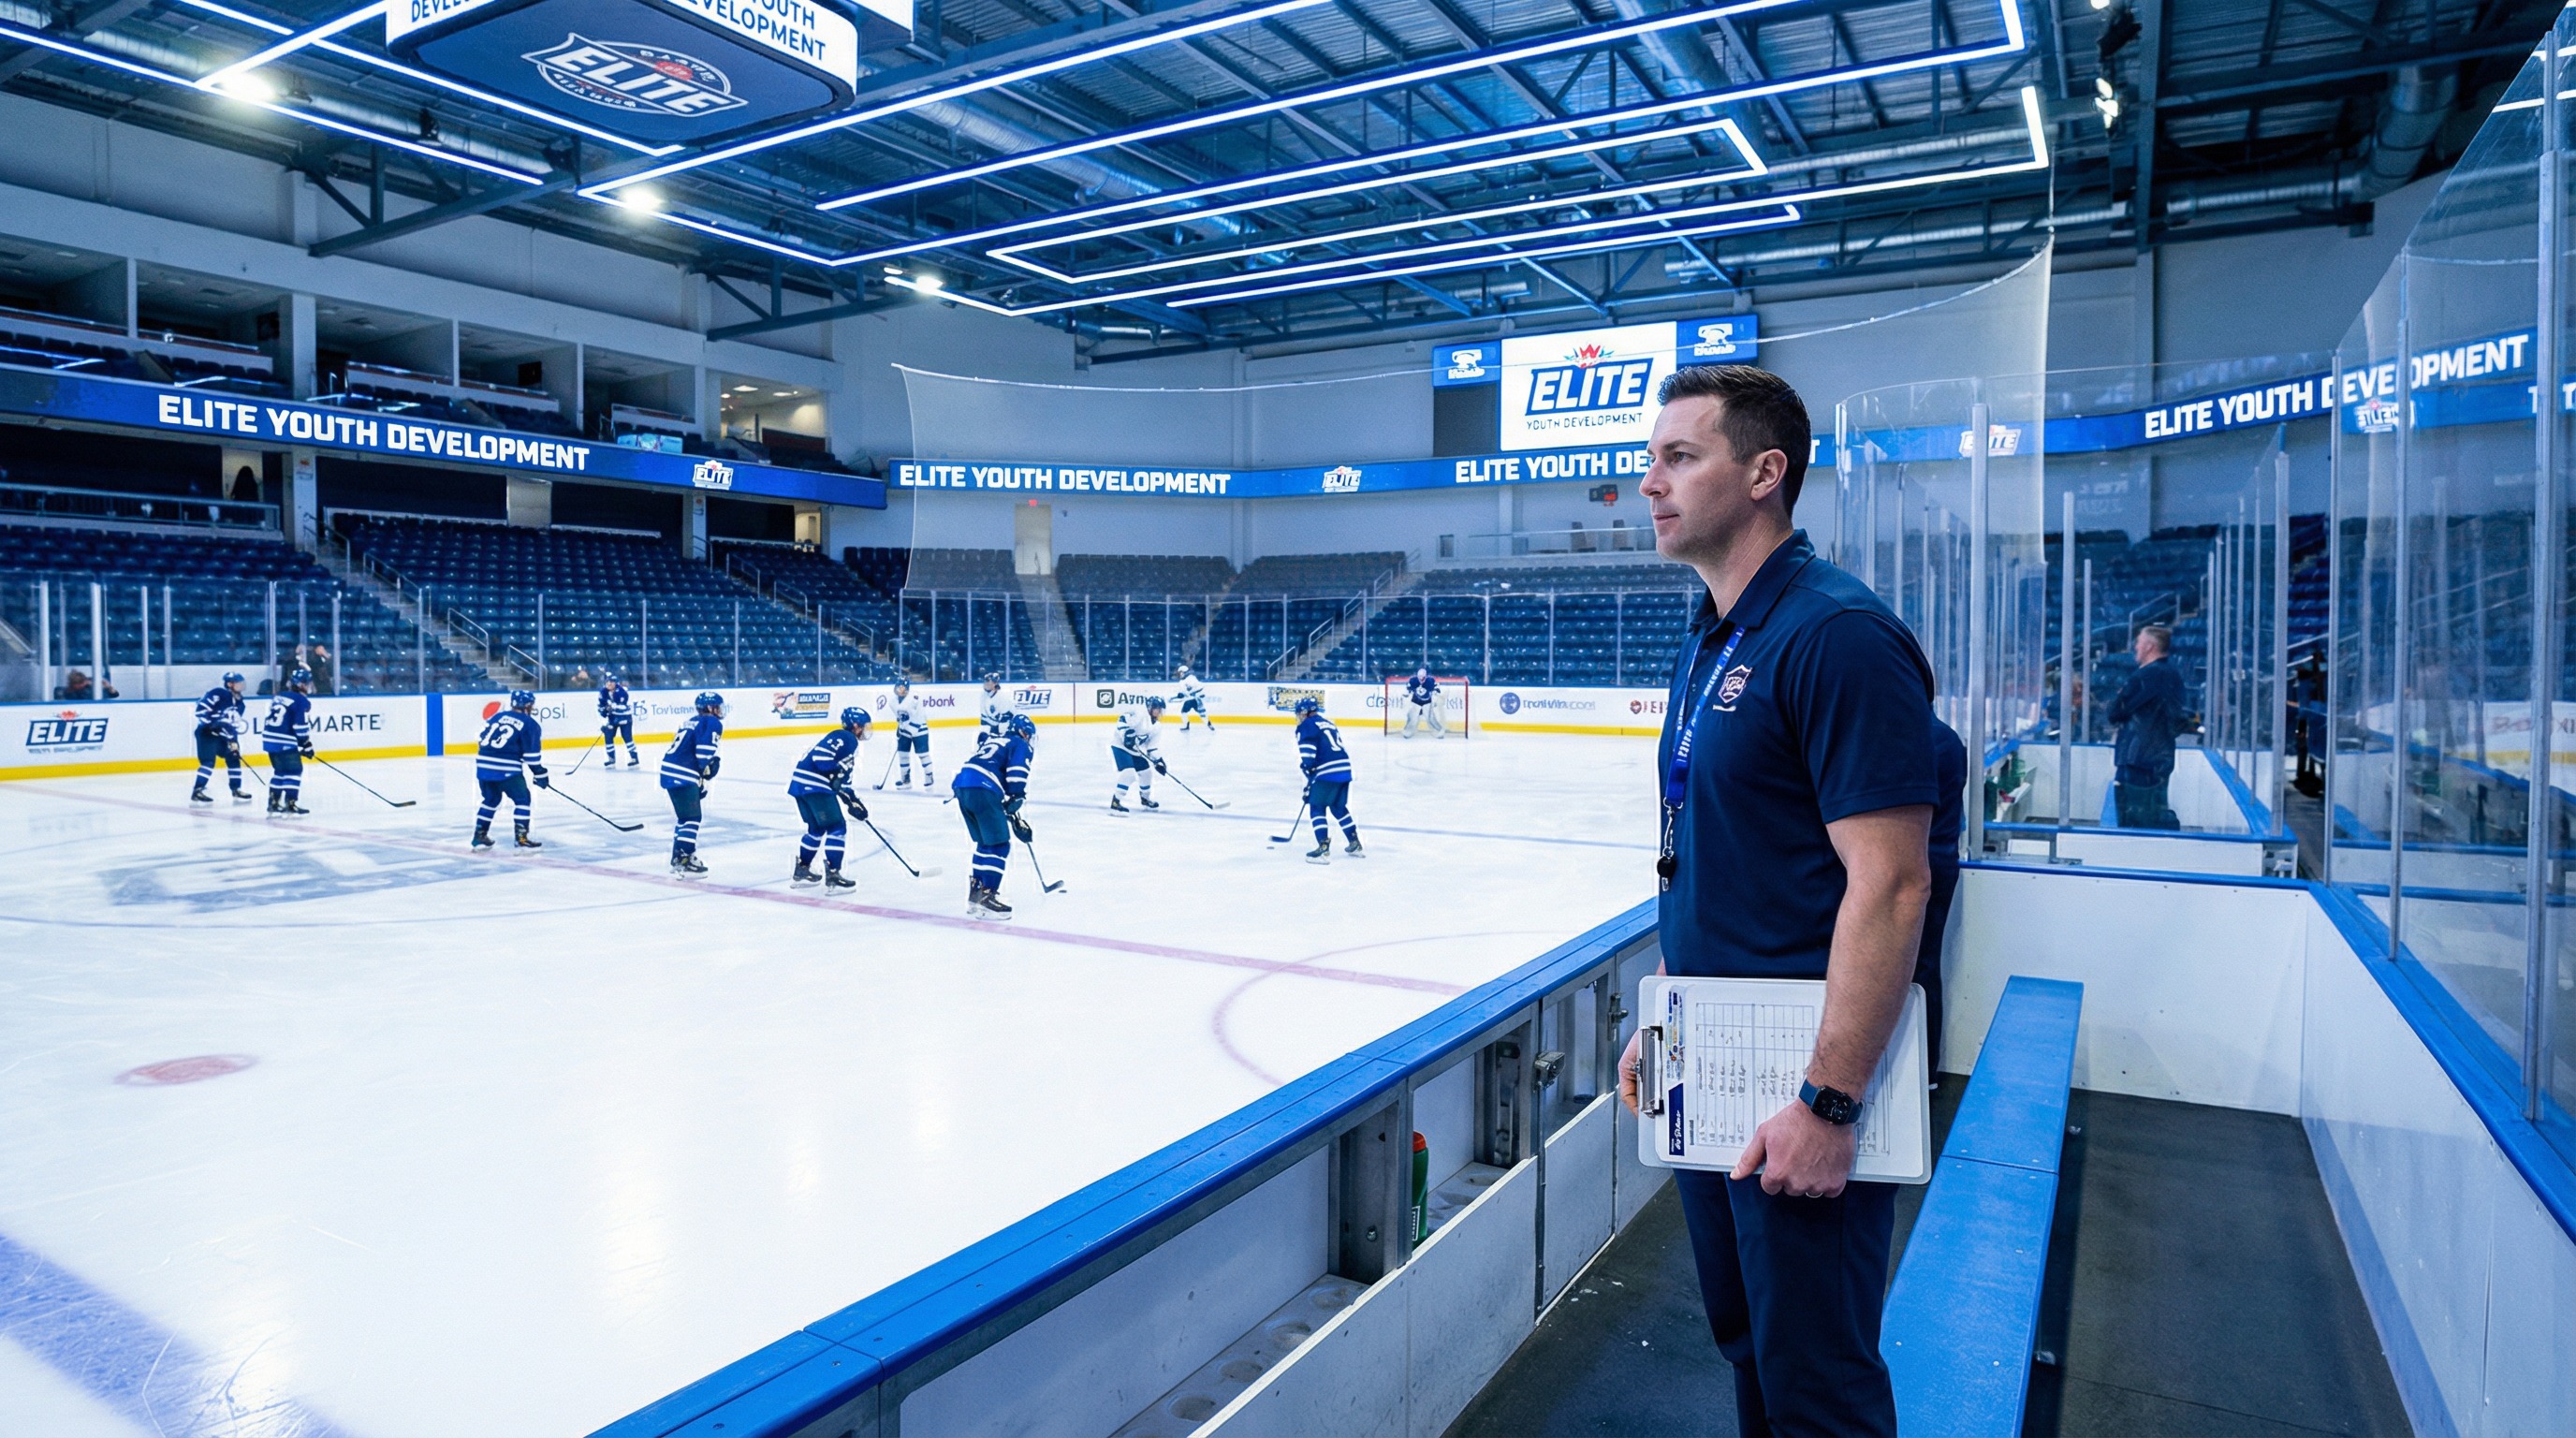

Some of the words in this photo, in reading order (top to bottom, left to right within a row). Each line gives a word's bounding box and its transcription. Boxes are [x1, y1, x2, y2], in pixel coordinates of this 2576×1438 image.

[544, 47, 733, 113] ELITE
[1530, 362, 1648, 411] ELITE
[2144, 400, 2214, 439] ELITE
[2217, 379, 2313, 425] YOUTH
[2320, 333, 2529, 409] DEVEOPMENT
[158, 394, 258, 433] ELITE
[266, 407, 378, 447] YOUTH
[387, 423, 590, 471] DEVELOPMENT
[1527, 418, 1560, 431] YOUTH
[1564, 412, 1643, 428] DEVELOPMENT
[900, 464, 966, 488] ELITE
[971, 466, 1052, 490] YOUTH
[1059, 469, 1232, 494] DEVELOPMENT
[1456, 458, 1520, 483] ELITE
[1526, 451, 1609, 479] YOUTH
[30, 720, 107, 743] ELITE
